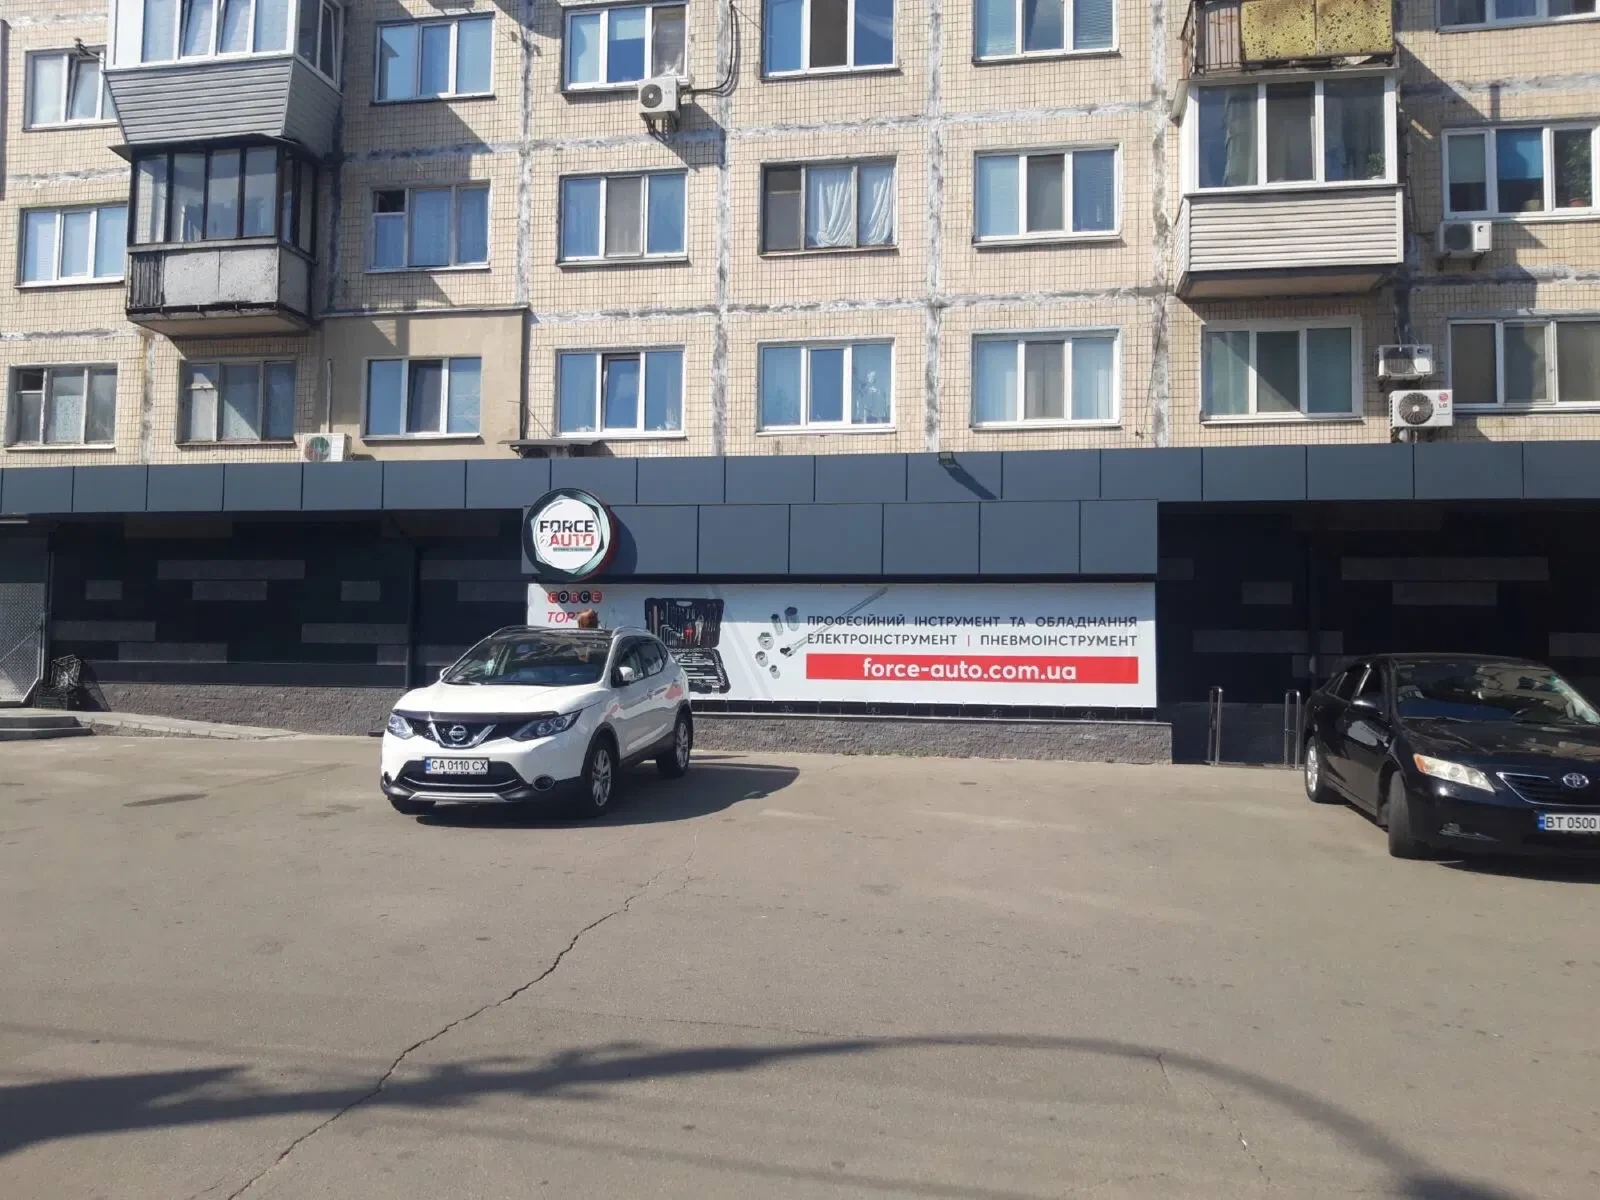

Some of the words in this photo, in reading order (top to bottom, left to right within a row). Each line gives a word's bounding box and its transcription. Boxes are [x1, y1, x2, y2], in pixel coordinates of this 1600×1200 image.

[539, 520, 595, 533] FORCE
[550, 534, 595, 547] AUTO
[548, 591, 602, 604] FORCE
[547, 611, 600, 623] TOP
[807, 614, 905, 627] ПРОФЕСІЙНИЙ
[914, 616, 1000, 627] ІНСТРУМЕНТ
[1010, 616, 1026, 627] ТА
[1035, 616, 1137, 628] ОБЛАДНАННЯ
[807, 633, 957, 645] ЕЛЕКТРОІНСТРУМЕНТ
[980, 635, 1138, 646] ПНЕВМОІНСТРУМЕНТ
[863, 657, 1077, 680] force-auto.com.ua
[431, 760, 446, 770] CA
[447, 760, 470, 771] 0110
[471, 760, 487, 771] CX
[1545, 816, 1564, 829] BT
[1566, 816, 1597, 829] 0500
